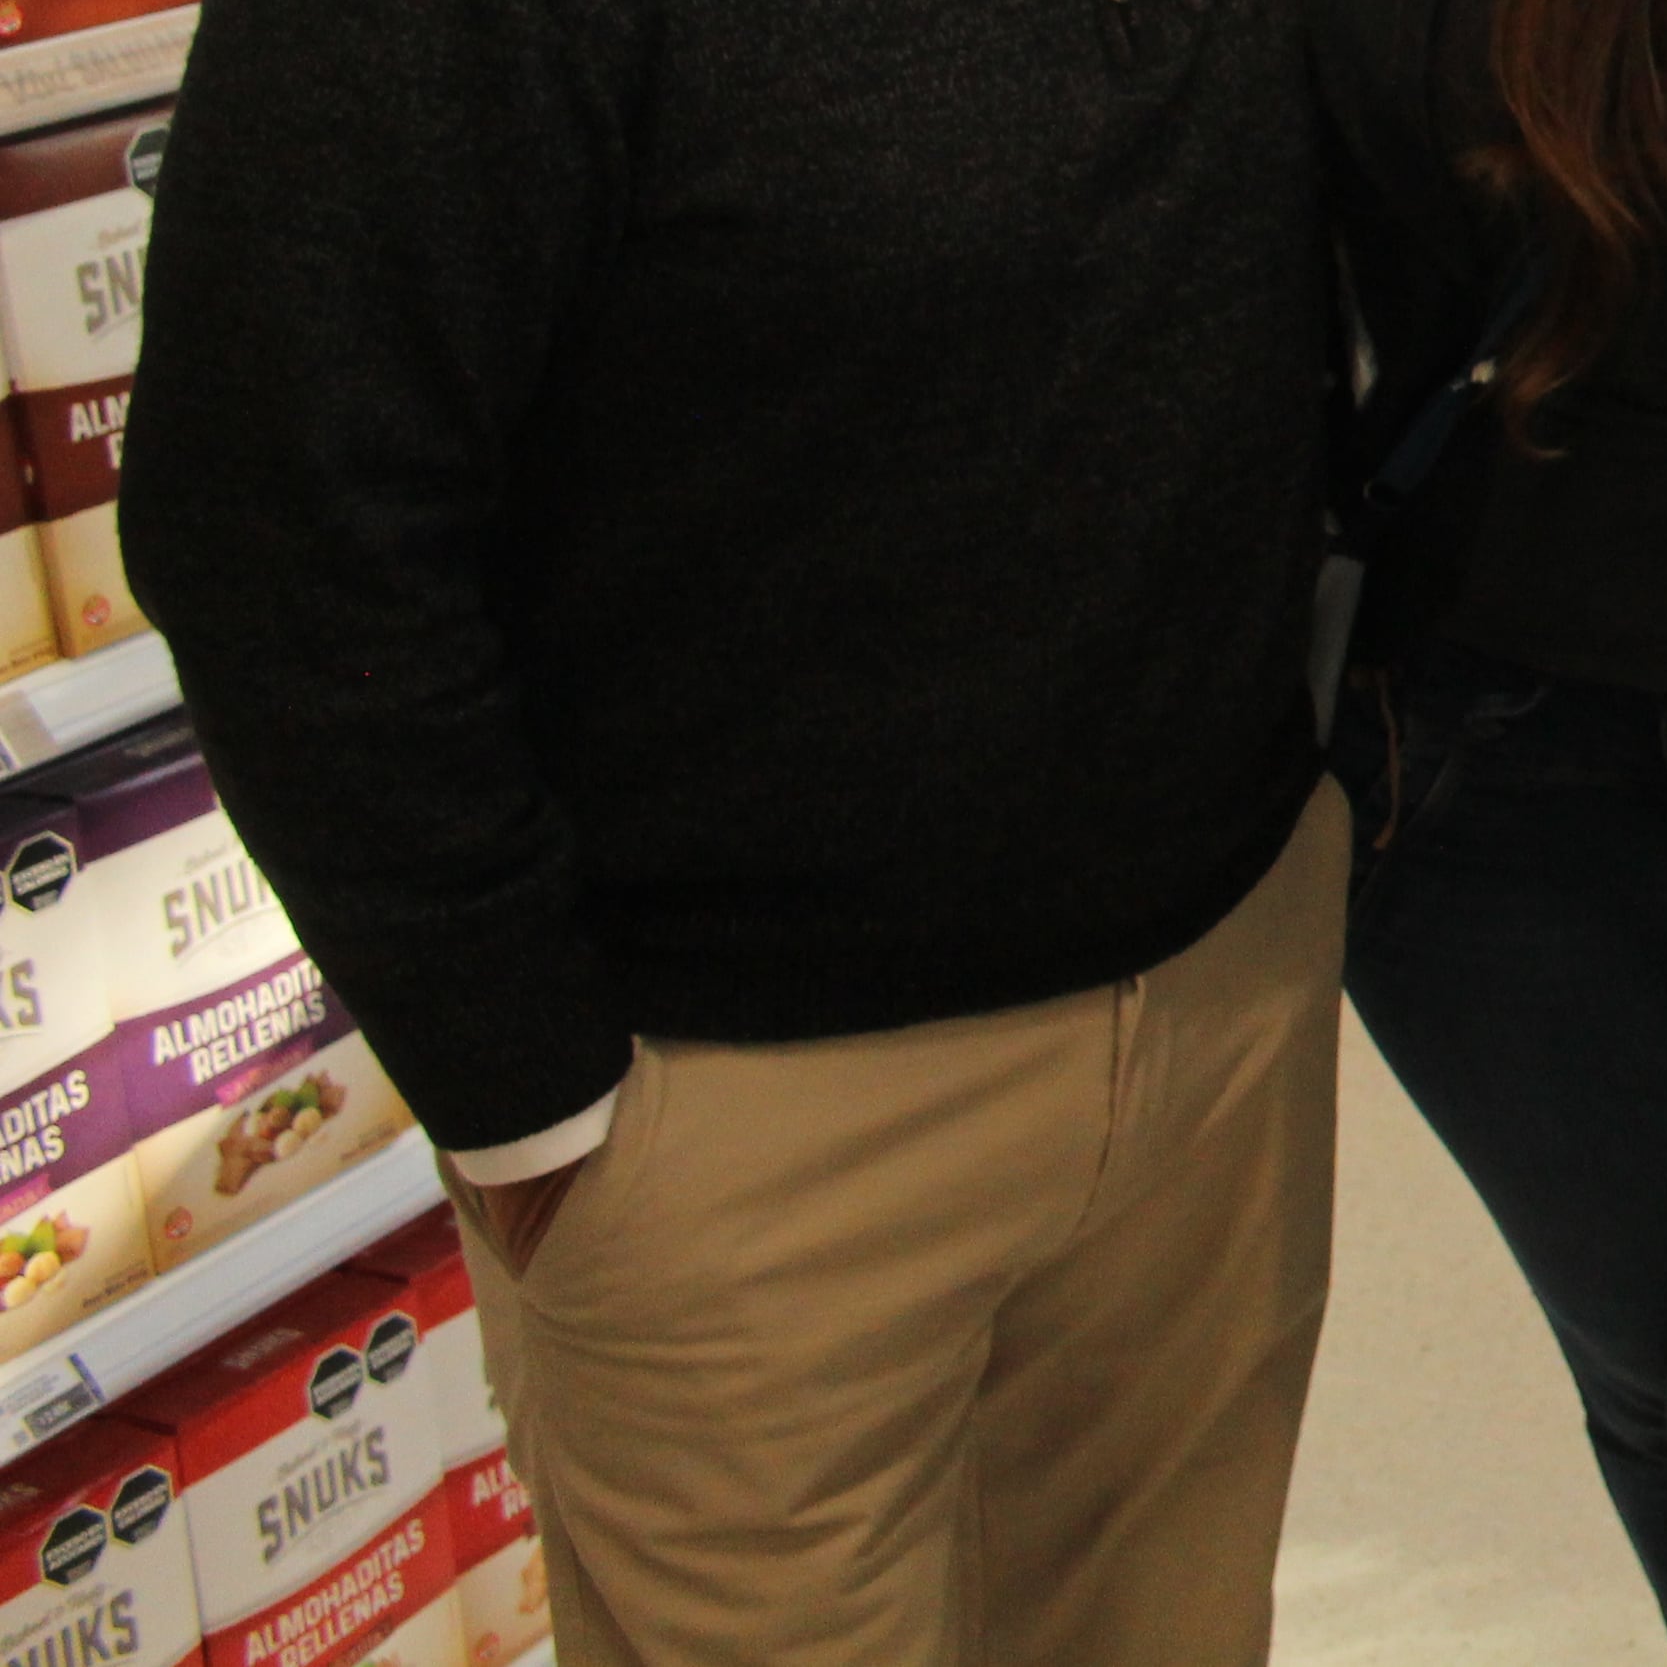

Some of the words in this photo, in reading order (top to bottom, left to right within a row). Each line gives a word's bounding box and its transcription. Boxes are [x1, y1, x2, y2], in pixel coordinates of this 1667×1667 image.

[190, 990, 327, 1086] RELLENAS
[257, 1425, 392, 1566] SNUKS
[244, 1517, 426, 1667] ALMOHADITAS
[279, 1570, 406, 1667] RELLENAS
